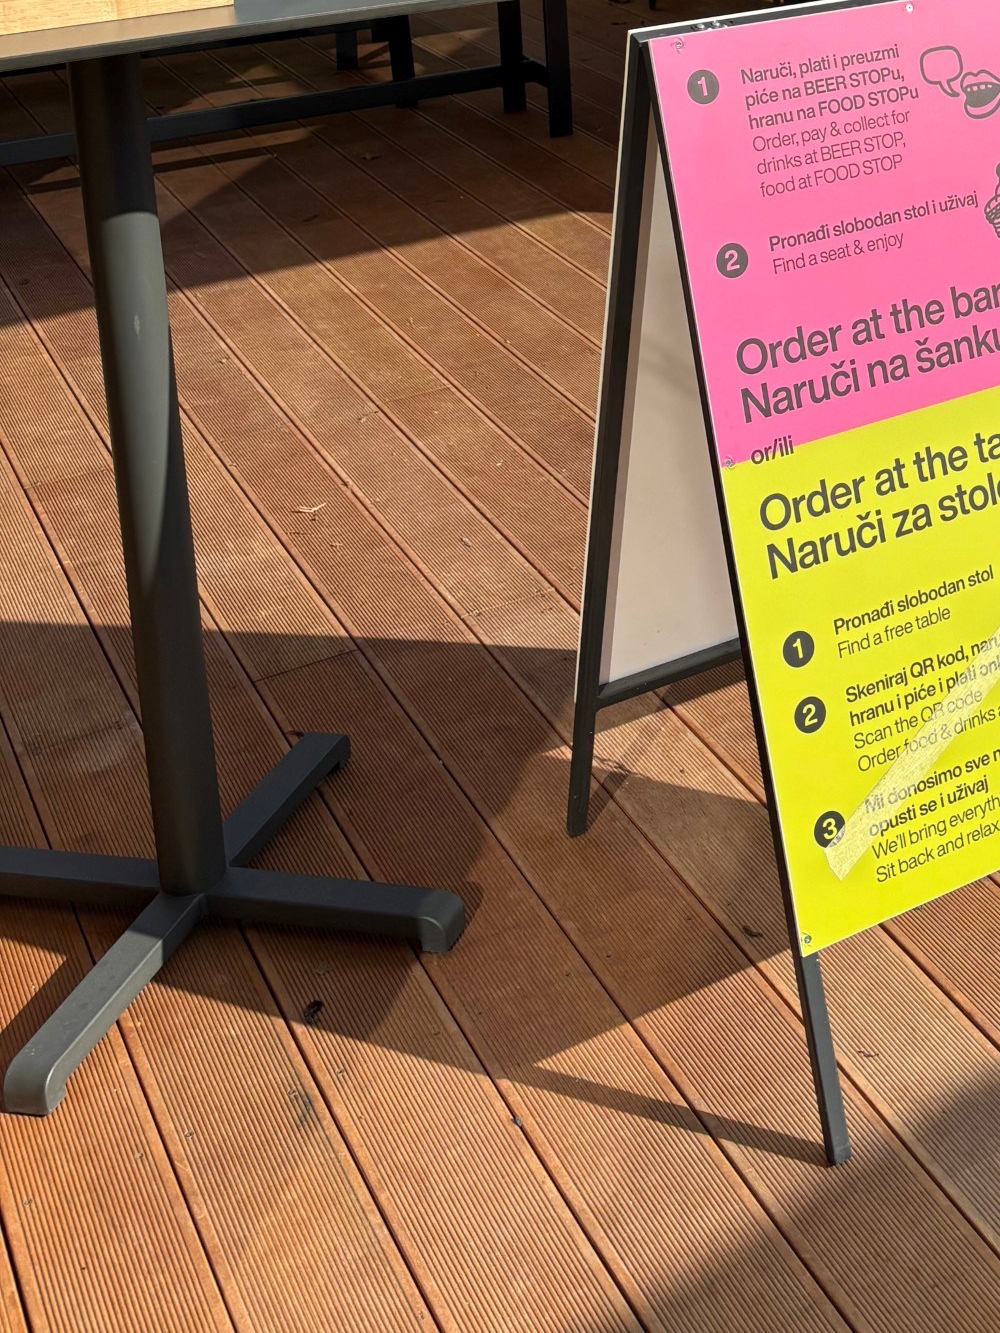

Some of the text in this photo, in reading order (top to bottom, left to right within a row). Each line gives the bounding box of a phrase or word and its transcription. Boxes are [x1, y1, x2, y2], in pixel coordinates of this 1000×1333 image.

[740, 43, 900, 85] Naruči, plati i preuzmi
[744, 67, 905, 111] piće na BEER STOPu,
[748, 85, 919, 130] hranu na FOOD STOPu
[752, 109, 910, 152] Order, pay & collect for
[756, 131, 906, 175] drinks at BEER STOP,
[759, 153, 903, 198] food at FOOD STOP
[768, 190, 979, 252] Pronađi slobodan stol i uživaj
[772, 232, 904, 275] Find a seat & enjoy
[735, 324, 843, 375] Order
[851, 308, 886, 346] at
[889, 298, 945, 335] the
[740, 358, 861, 424] Naruči
[866, 353, 910, 388] na
[750, 434, 795, 465] or/ili
[759, 475, 866, 531] Order
[874, 457, 909, 497] at
[912, 445, 969, 483] the
[766, 508, 887, 580] Naruči
[891, 503, 933, 539] za
[833, 563, 994, 636] Pronađi slobodan stol
[837, 606, 951, 659] Find a free table
[845, 666, 909, 703] Skeniraj
[909, 656, 935, 679] QR
[936, 644, 969, 670] kod,
[849, 699, 895, 727] hranu
[895, 693, 902, 710] i
[903, 683, 937, 711] piće
[937, 677, 944, 693] i
[853, 725, 893, 750] Scan
[893, 715, 919, 734] the
[857, 744, 901, 772] Order
[953, 708, 997, 735] drinks
[964, 753, 991, 774] sve
[869, 773, 989, 838] opusti se i uživaj
[875, 819, 1000, 883] Sit back and relax
[907, 819, 947, 846] bring
